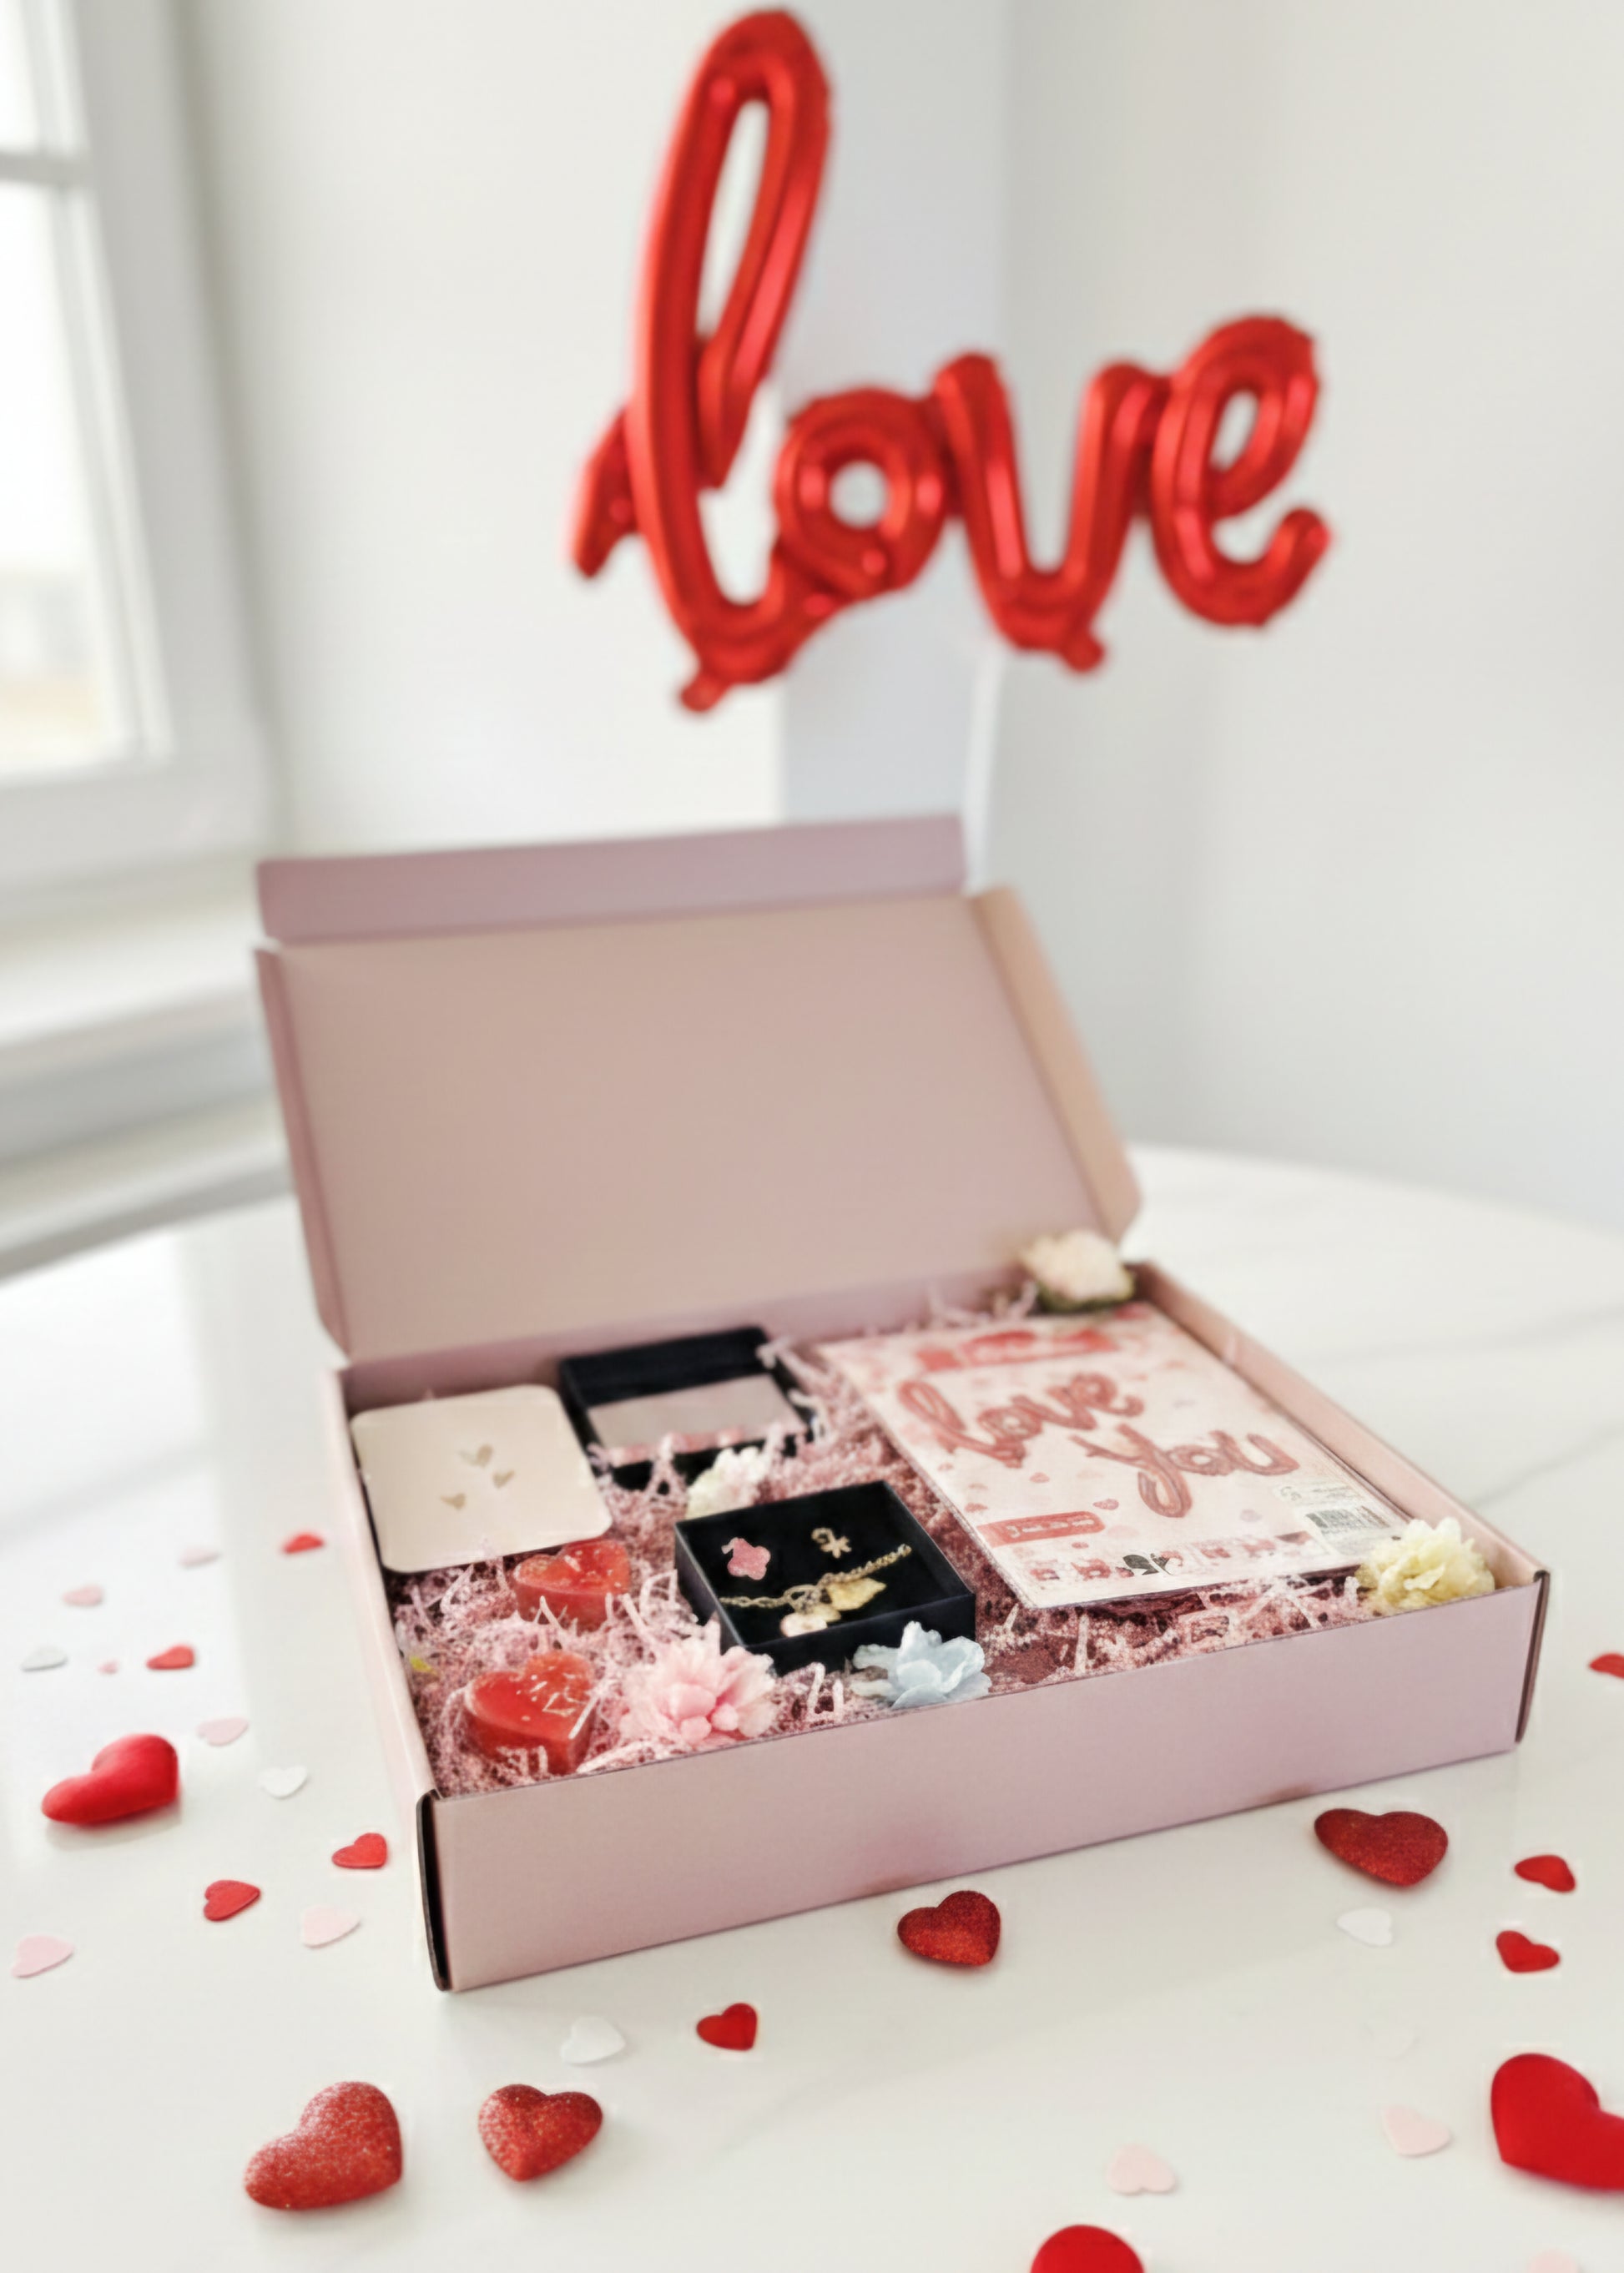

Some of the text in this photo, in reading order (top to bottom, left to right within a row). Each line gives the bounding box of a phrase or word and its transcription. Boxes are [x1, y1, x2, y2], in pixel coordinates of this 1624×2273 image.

[572, 8, 1333, 713] love
[897, 1373, 1144, 1469] love
[1071, 1424, 1300, 1518] you
